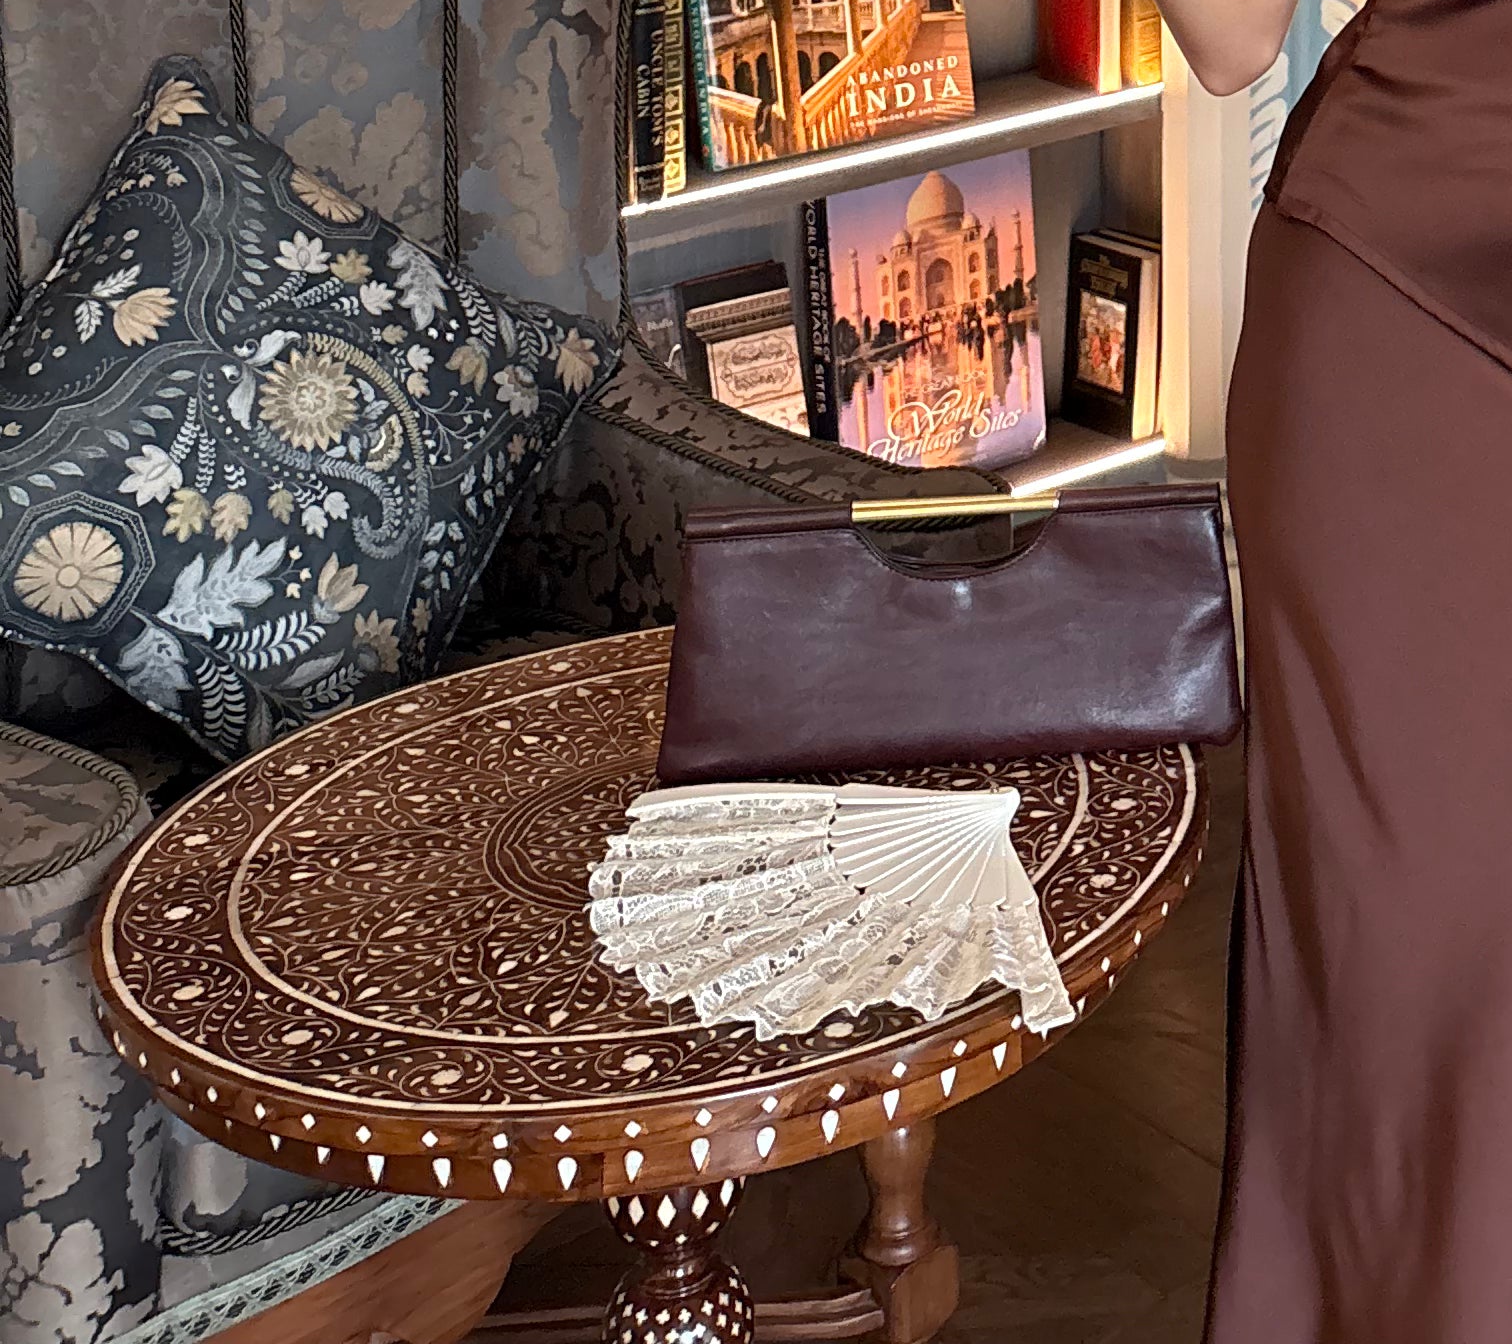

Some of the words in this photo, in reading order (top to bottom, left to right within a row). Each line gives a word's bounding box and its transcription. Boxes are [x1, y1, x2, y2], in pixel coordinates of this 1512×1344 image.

[650, 29, 663, 88] UNCLE
[846, 55, 958, 87] ABANDONED
[637, 64, 649, 119] CABIN
[697, 78, 708, 135] INDIA
[846, 74, 961, 117] INDIA
[651, 94, 664, 146] TOM'S
[809, 265, 824, 359] HERITAGE
[814, 363, 826, 414] SITES
[887, 389, 985, 441] World
[867, 426, 966, 462] Heritage
[969, 408, 1023, 438] Sites
